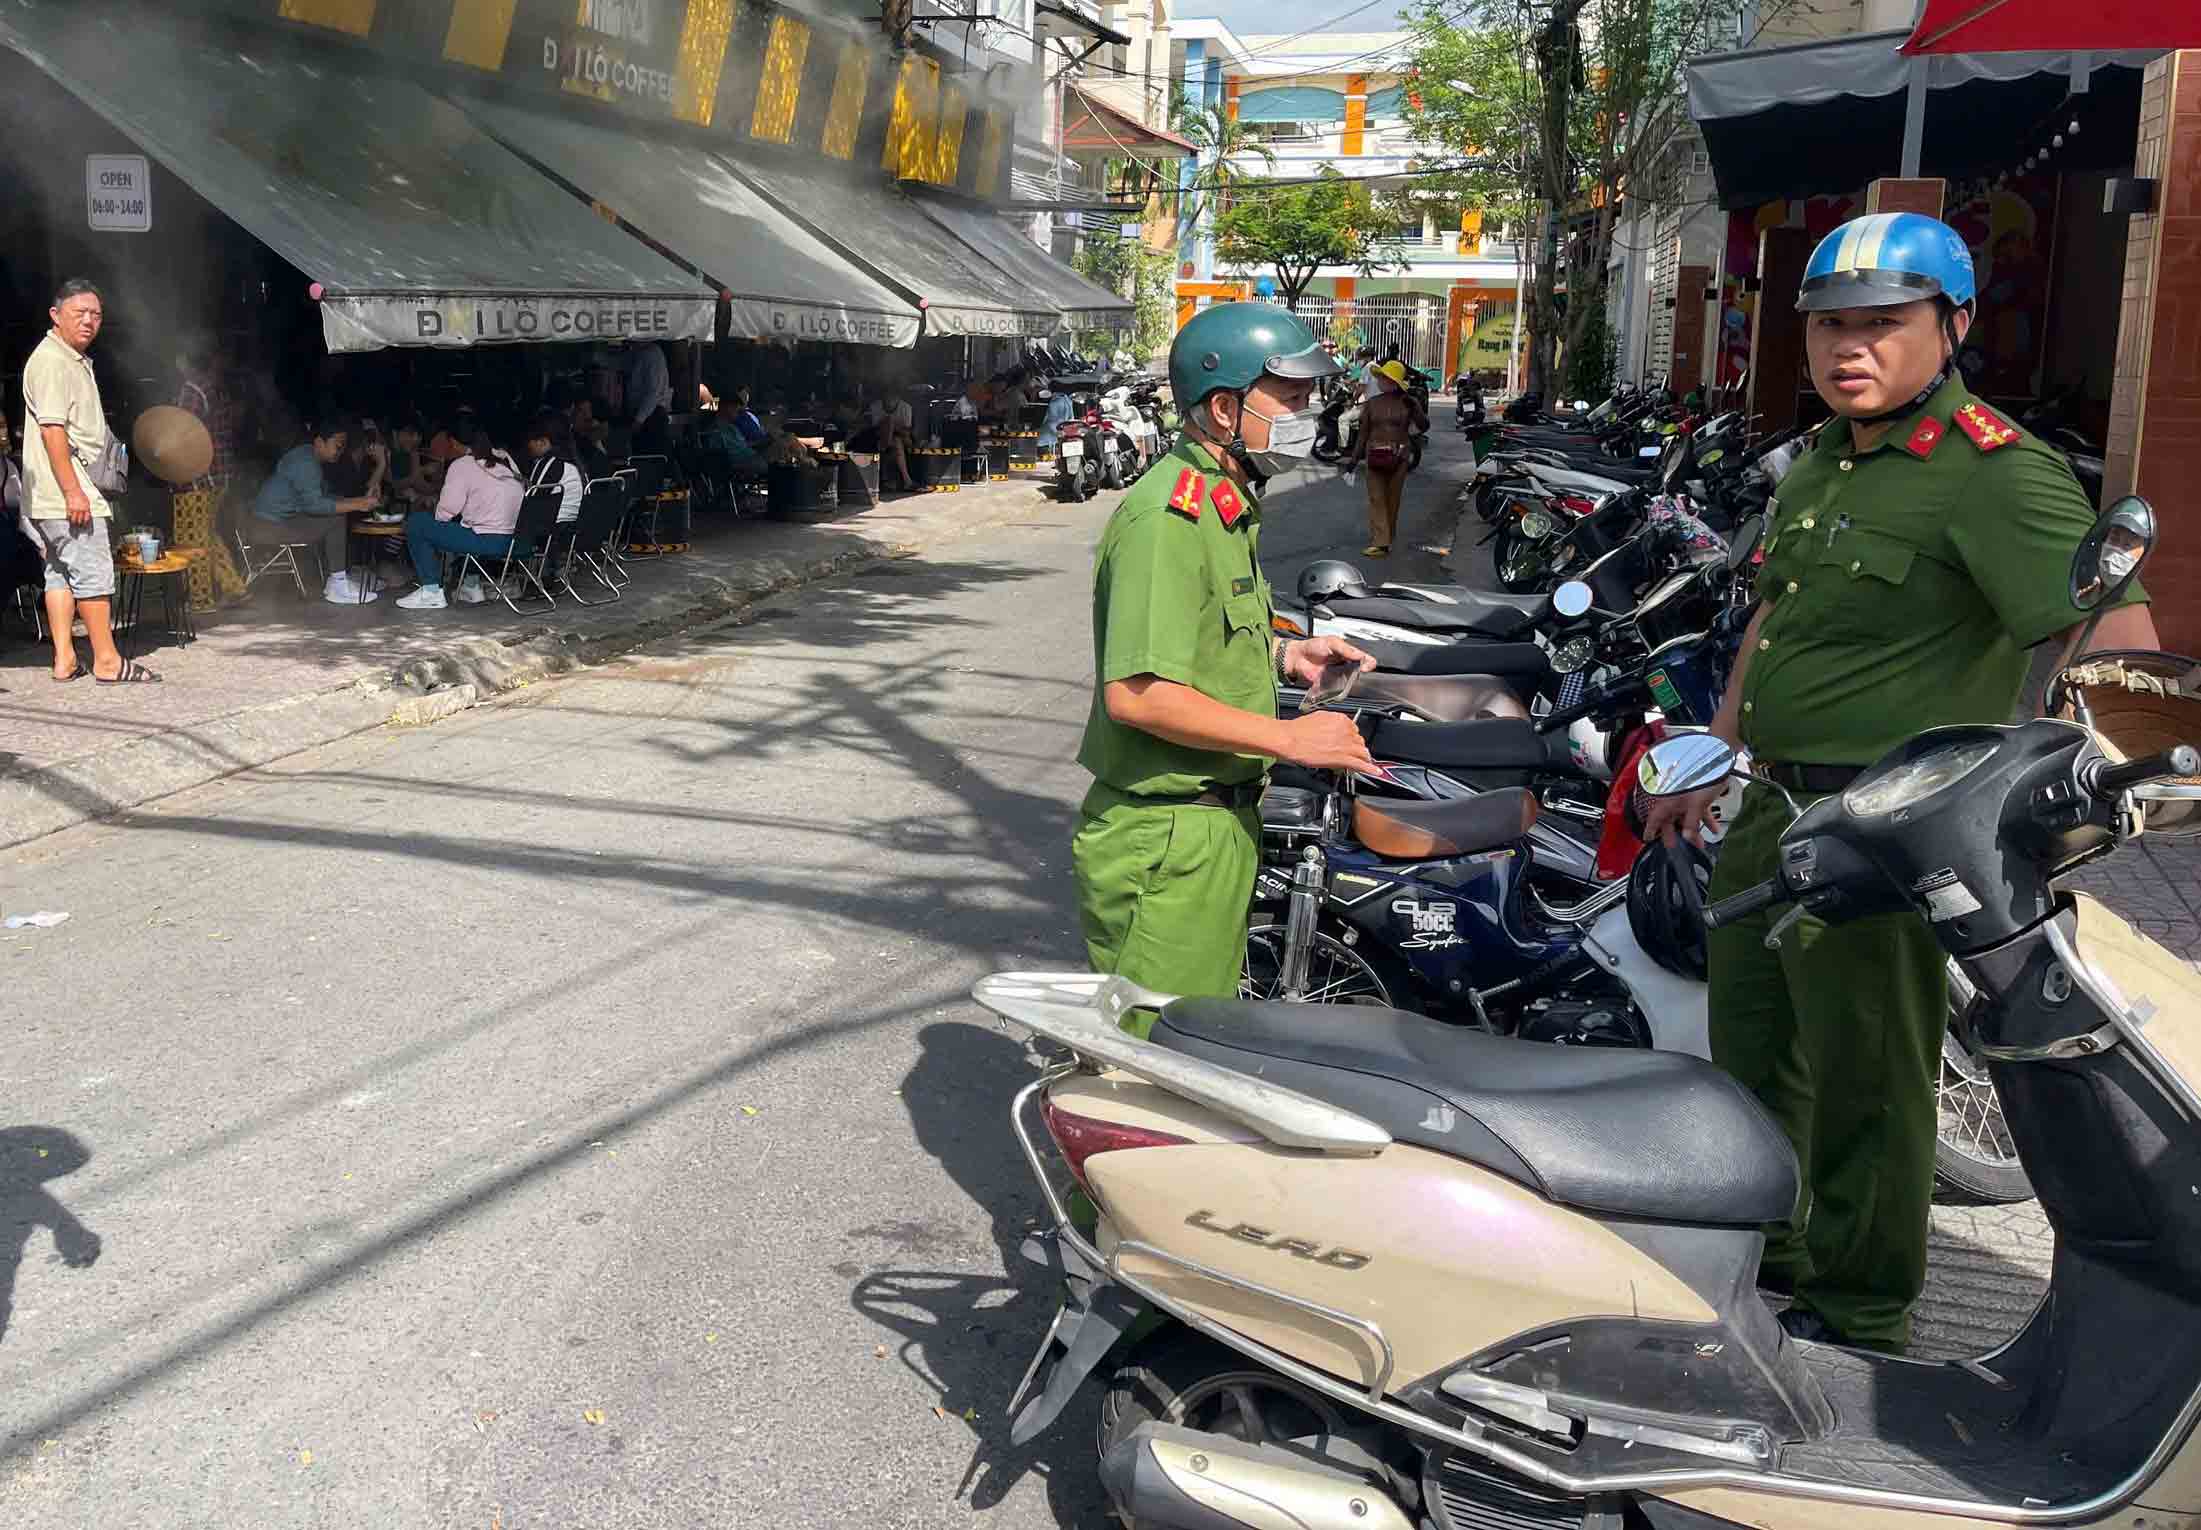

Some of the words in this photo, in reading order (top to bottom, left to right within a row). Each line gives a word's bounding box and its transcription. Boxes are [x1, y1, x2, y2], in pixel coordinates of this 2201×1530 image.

[101, 171, 133, 186] OPEN
[551, 309, 668, 333] COFFEE
[835, 319, 896, 339] COFFEE
[1184, 1210, 1373, 1271] LEAD
